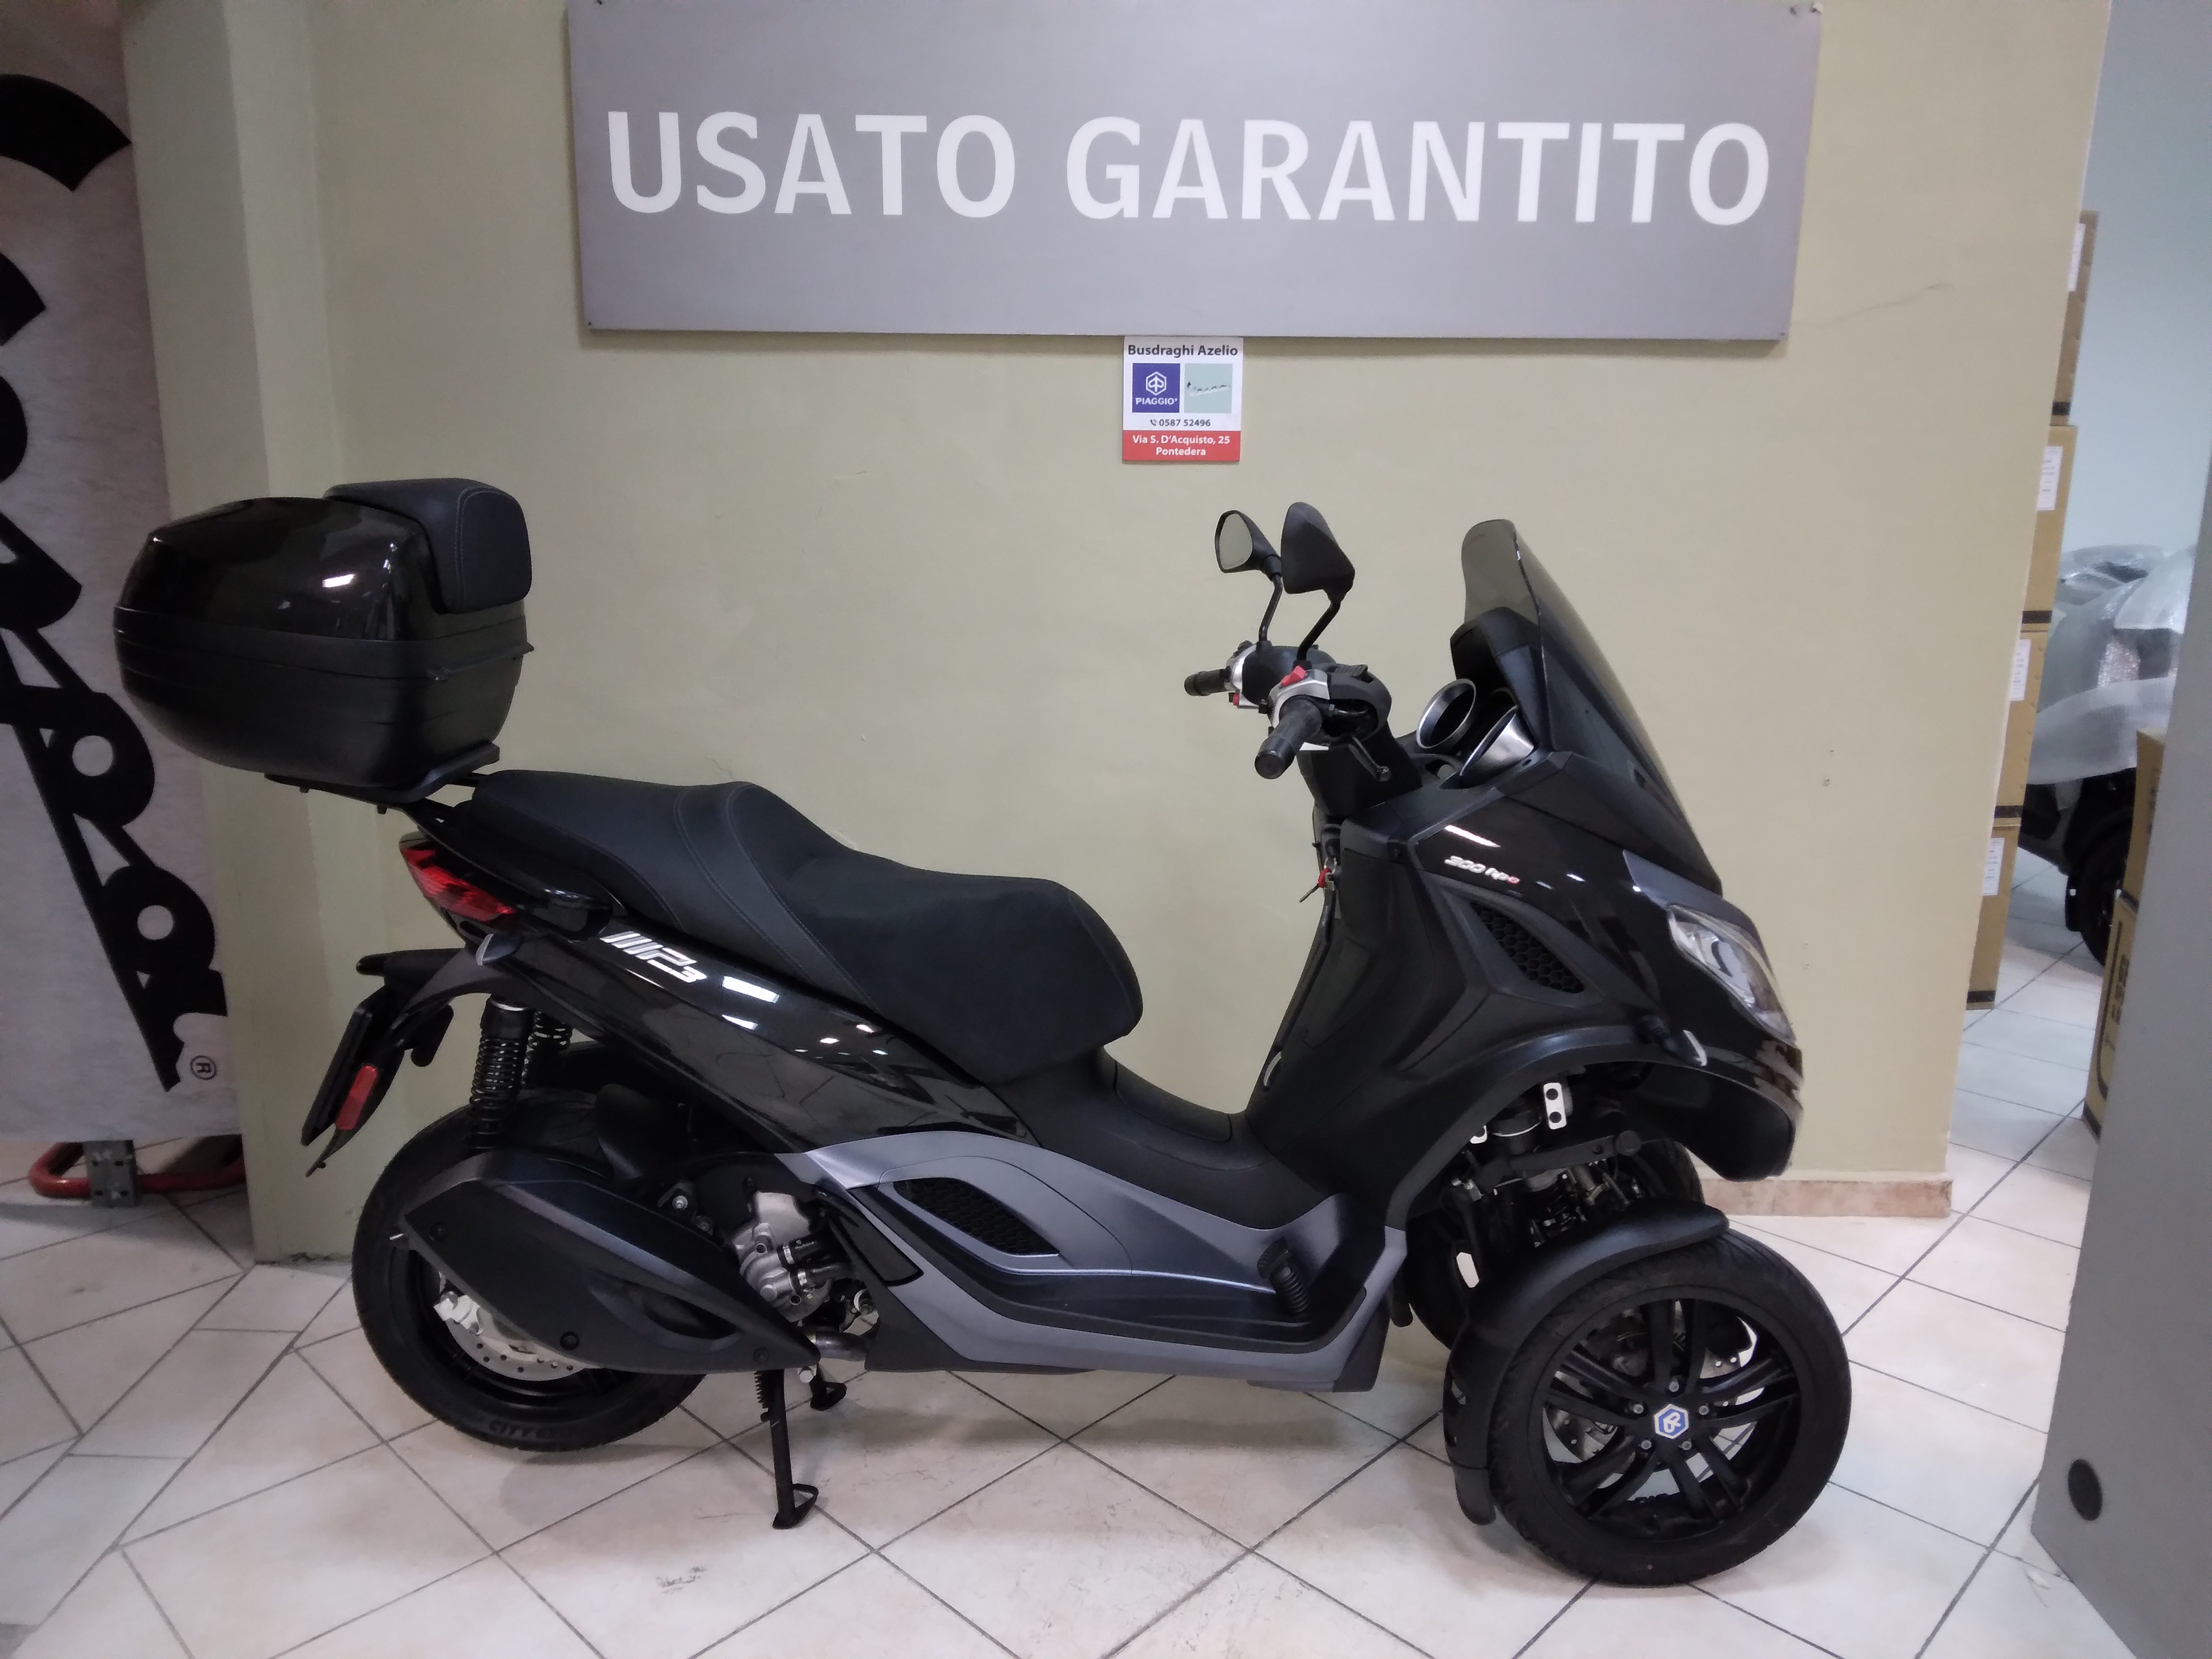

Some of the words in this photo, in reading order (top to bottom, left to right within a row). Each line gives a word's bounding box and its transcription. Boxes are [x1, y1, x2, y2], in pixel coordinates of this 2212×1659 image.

[608, 111, 1015, 218] USATO
[1067, 116, 1769, 226] GARANTITO
[1128, 344, 1194, 358] Busdraghi
[1197, 345, 1238, 356] Azelio
[1132, 435, 1148, 444] Via
[1150, 435, 1159, 444] S.
[1218, 435, 1230, 444] 25
[1156, 447, 1206, 456] Pontedera
